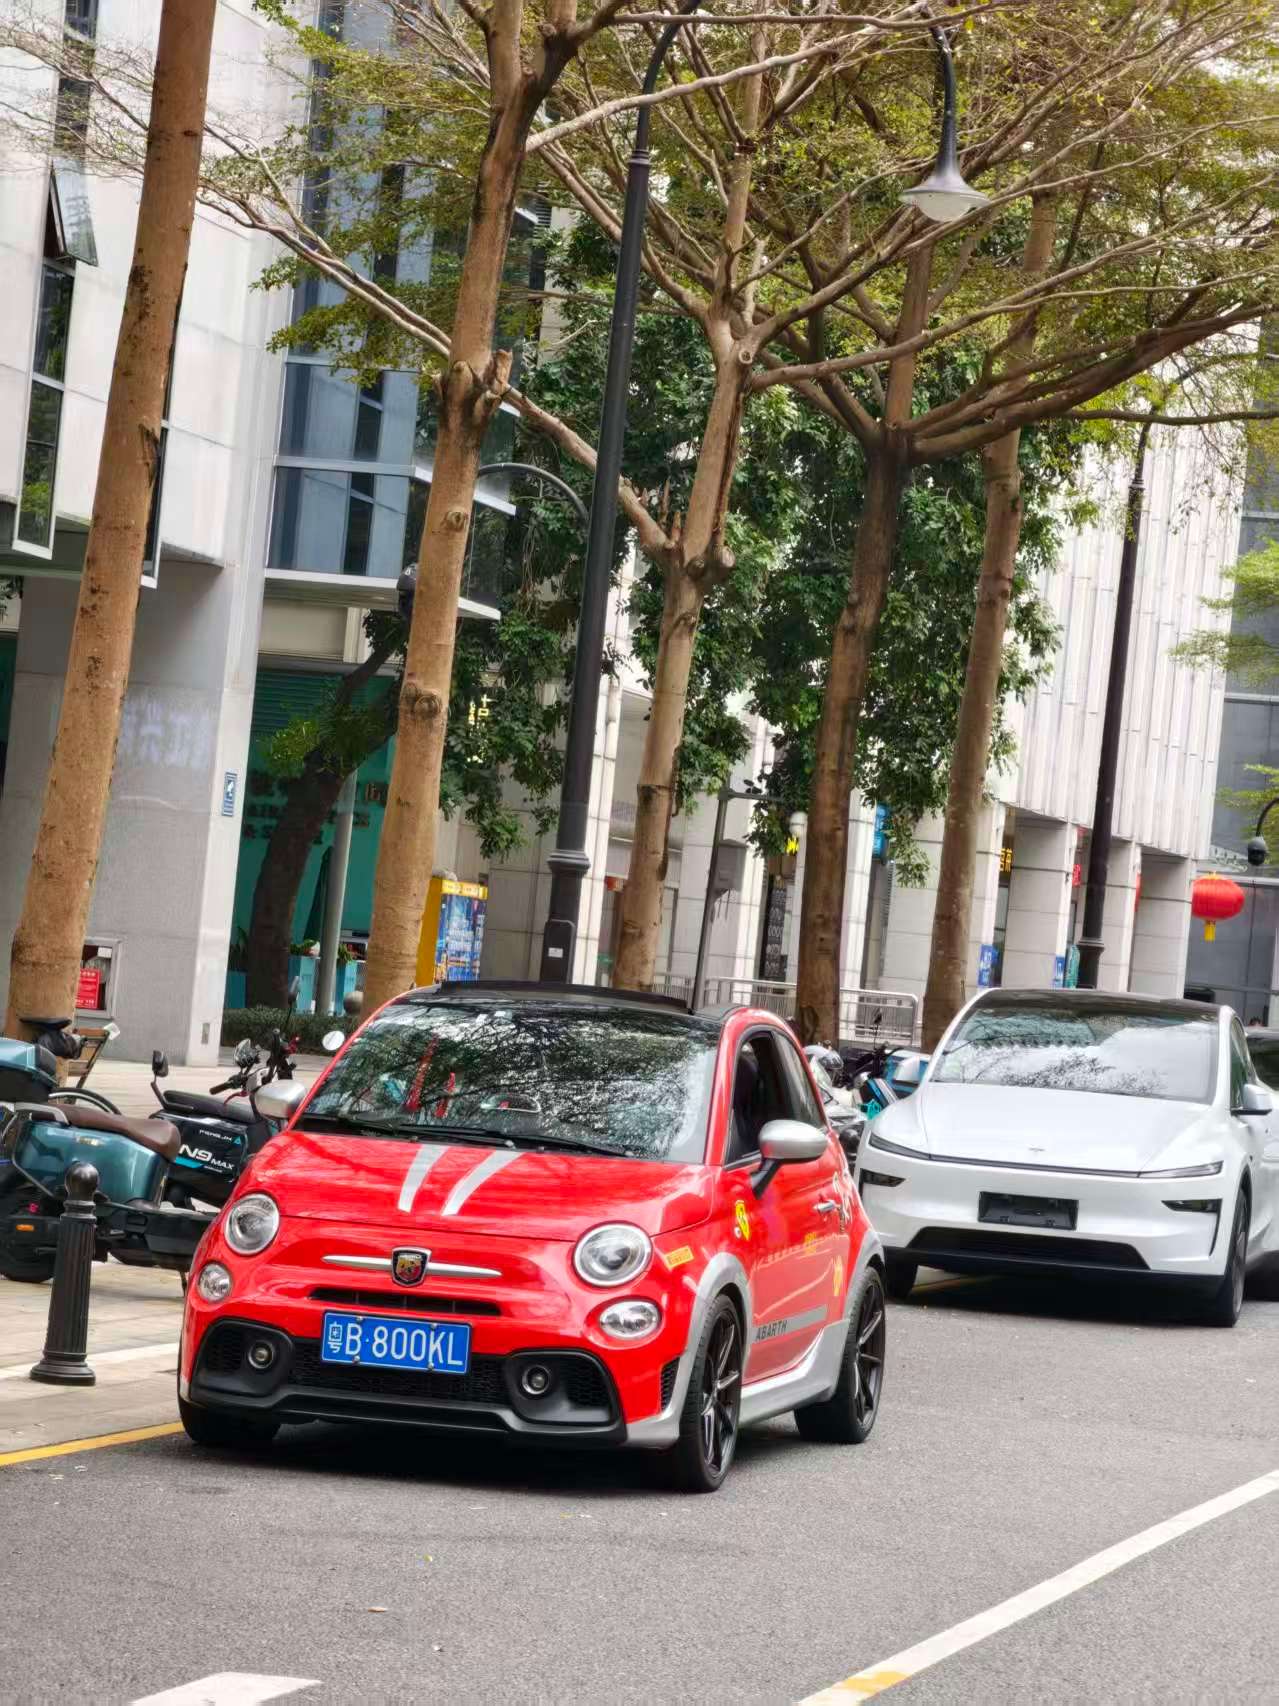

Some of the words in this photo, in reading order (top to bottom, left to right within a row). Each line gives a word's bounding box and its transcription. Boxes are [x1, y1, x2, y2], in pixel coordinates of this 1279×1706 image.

[179, 1143, 213, 1162] N9
[210, 1158, 235, 1170] MAX
[755, 1320, 788, 1341] ABARTH
